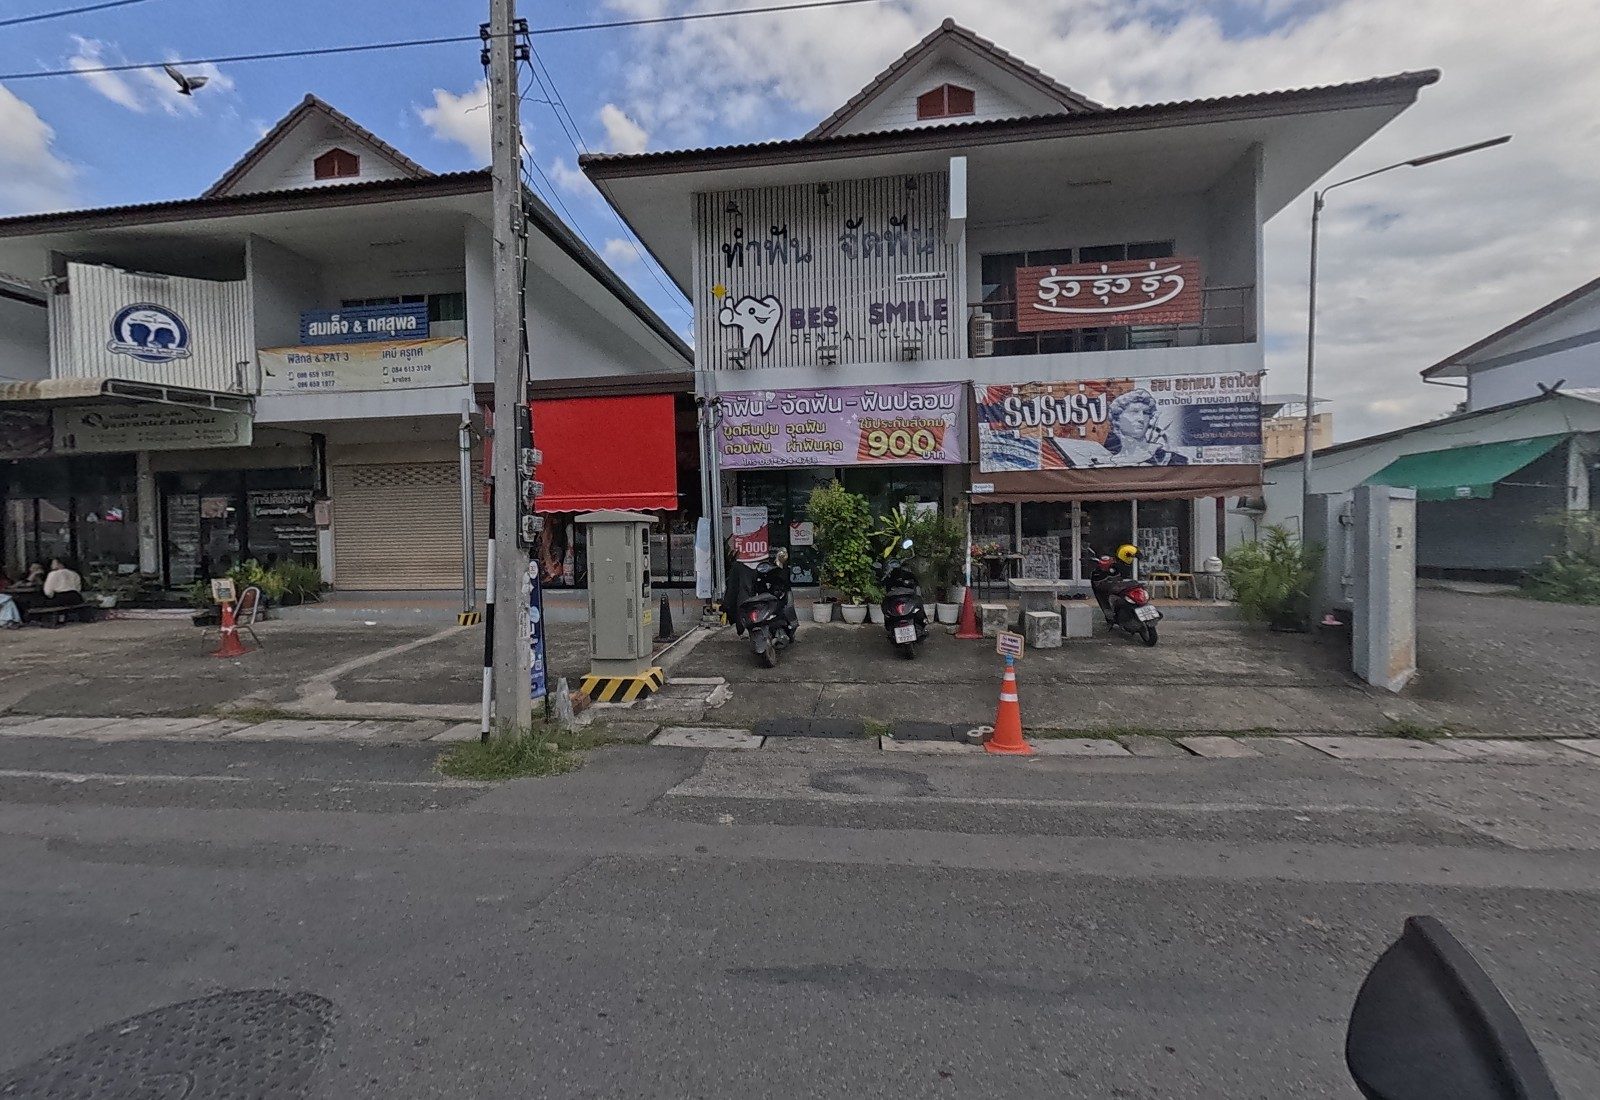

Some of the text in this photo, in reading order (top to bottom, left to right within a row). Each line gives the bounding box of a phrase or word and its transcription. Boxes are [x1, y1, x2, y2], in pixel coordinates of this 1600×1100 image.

[721, 215, 935, 268] ทำฟัน จัดฟัน
[790, 298, 948, 329] BES SMILE
[308, 314, 417, 337] สมเด็จ & ทศสุพล
[790, 324, 949, 345] DENTAL CLINIC
[323, 352, 342, 363] PAT
[343, 353, 350, 363] 3
[781, 391, 843, 415] จัดฟัน
[859, 389, 955, 412] ฟันปลอม
[723, 419, 827, 441] ขูดหินปูน อุดฟัน
[723, 440, 772, 456] ถอนฟัน
[867, 428, 936, 458] 900
